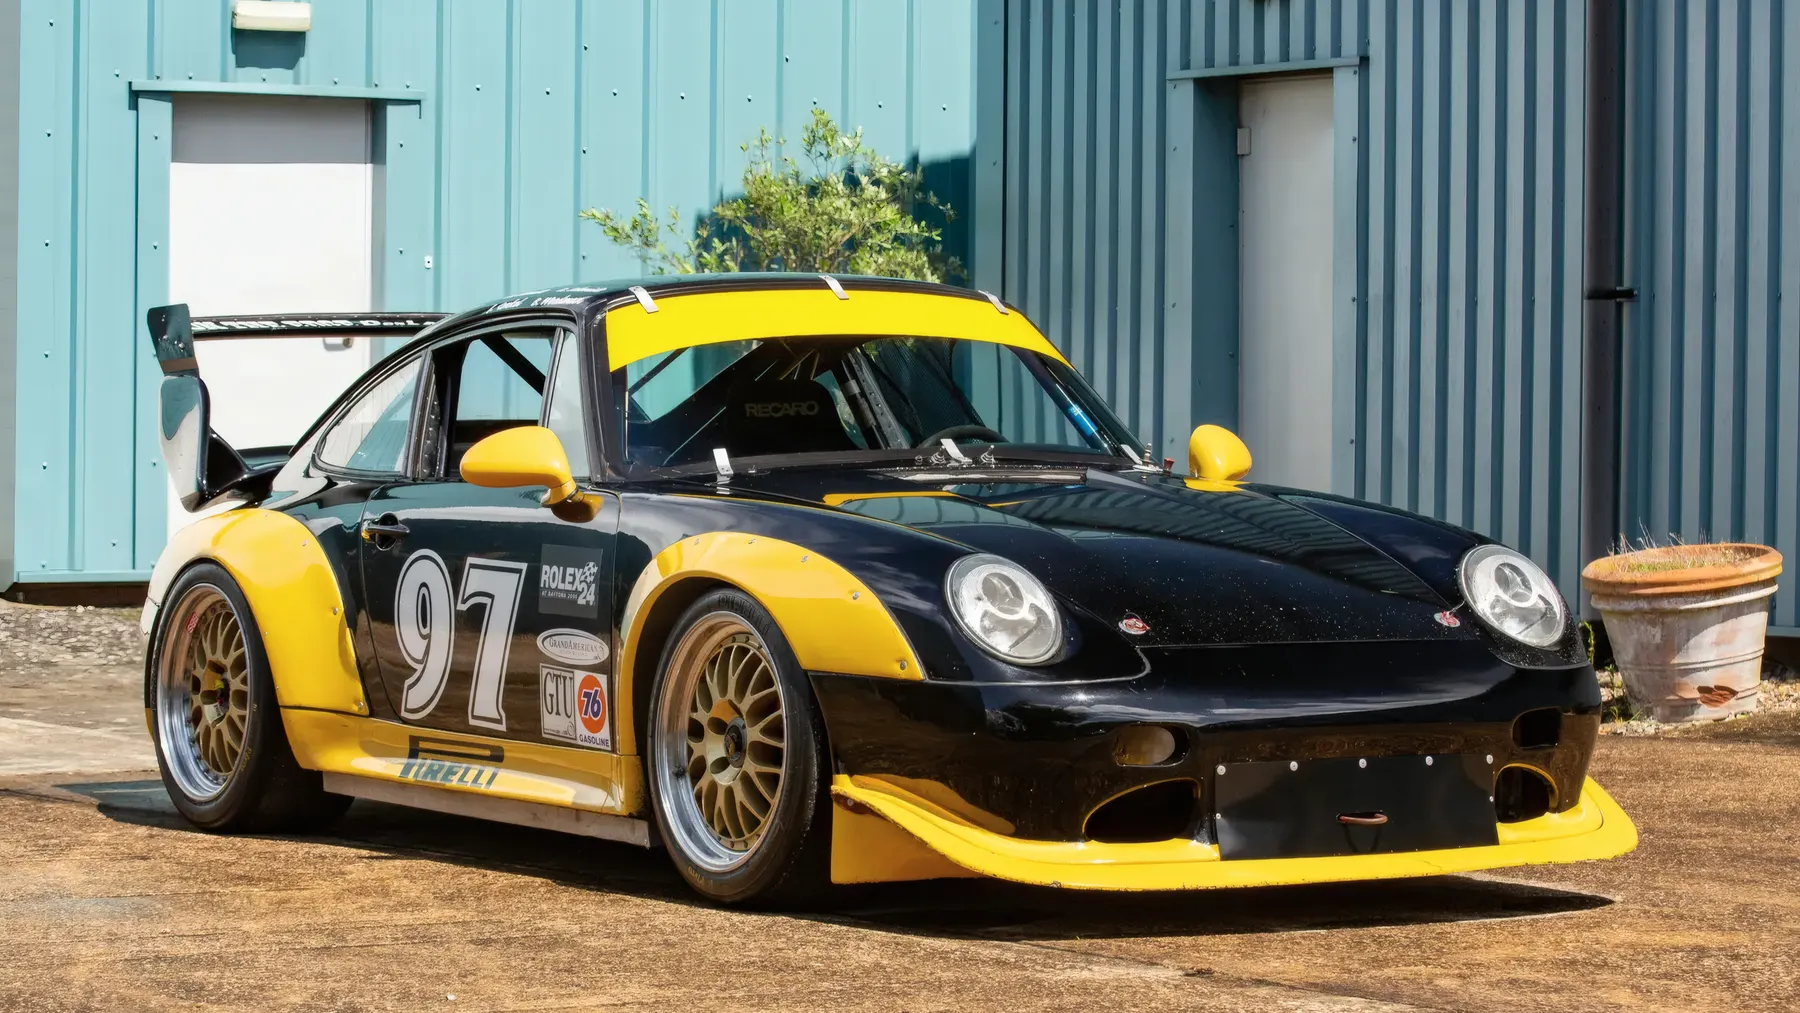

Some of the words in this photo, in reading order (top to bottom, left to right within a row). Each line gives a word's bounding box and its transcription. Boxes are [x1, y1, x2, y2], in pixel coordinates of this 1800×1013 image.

[745, 401, 819, 417] RECARO
[540, 565, 583, 591] ROLEX
[548, 590, 567, 599] DAYTONA
[577, 582, 596, 606] 24
[394, 548, 528, 732] 97
[543, 671, 574, 719] GTU
[581, 687, 603, 721] 76
[579, 734, 610, 747] GASOLINE
[399, 735, 504, 789] PIRELLI
